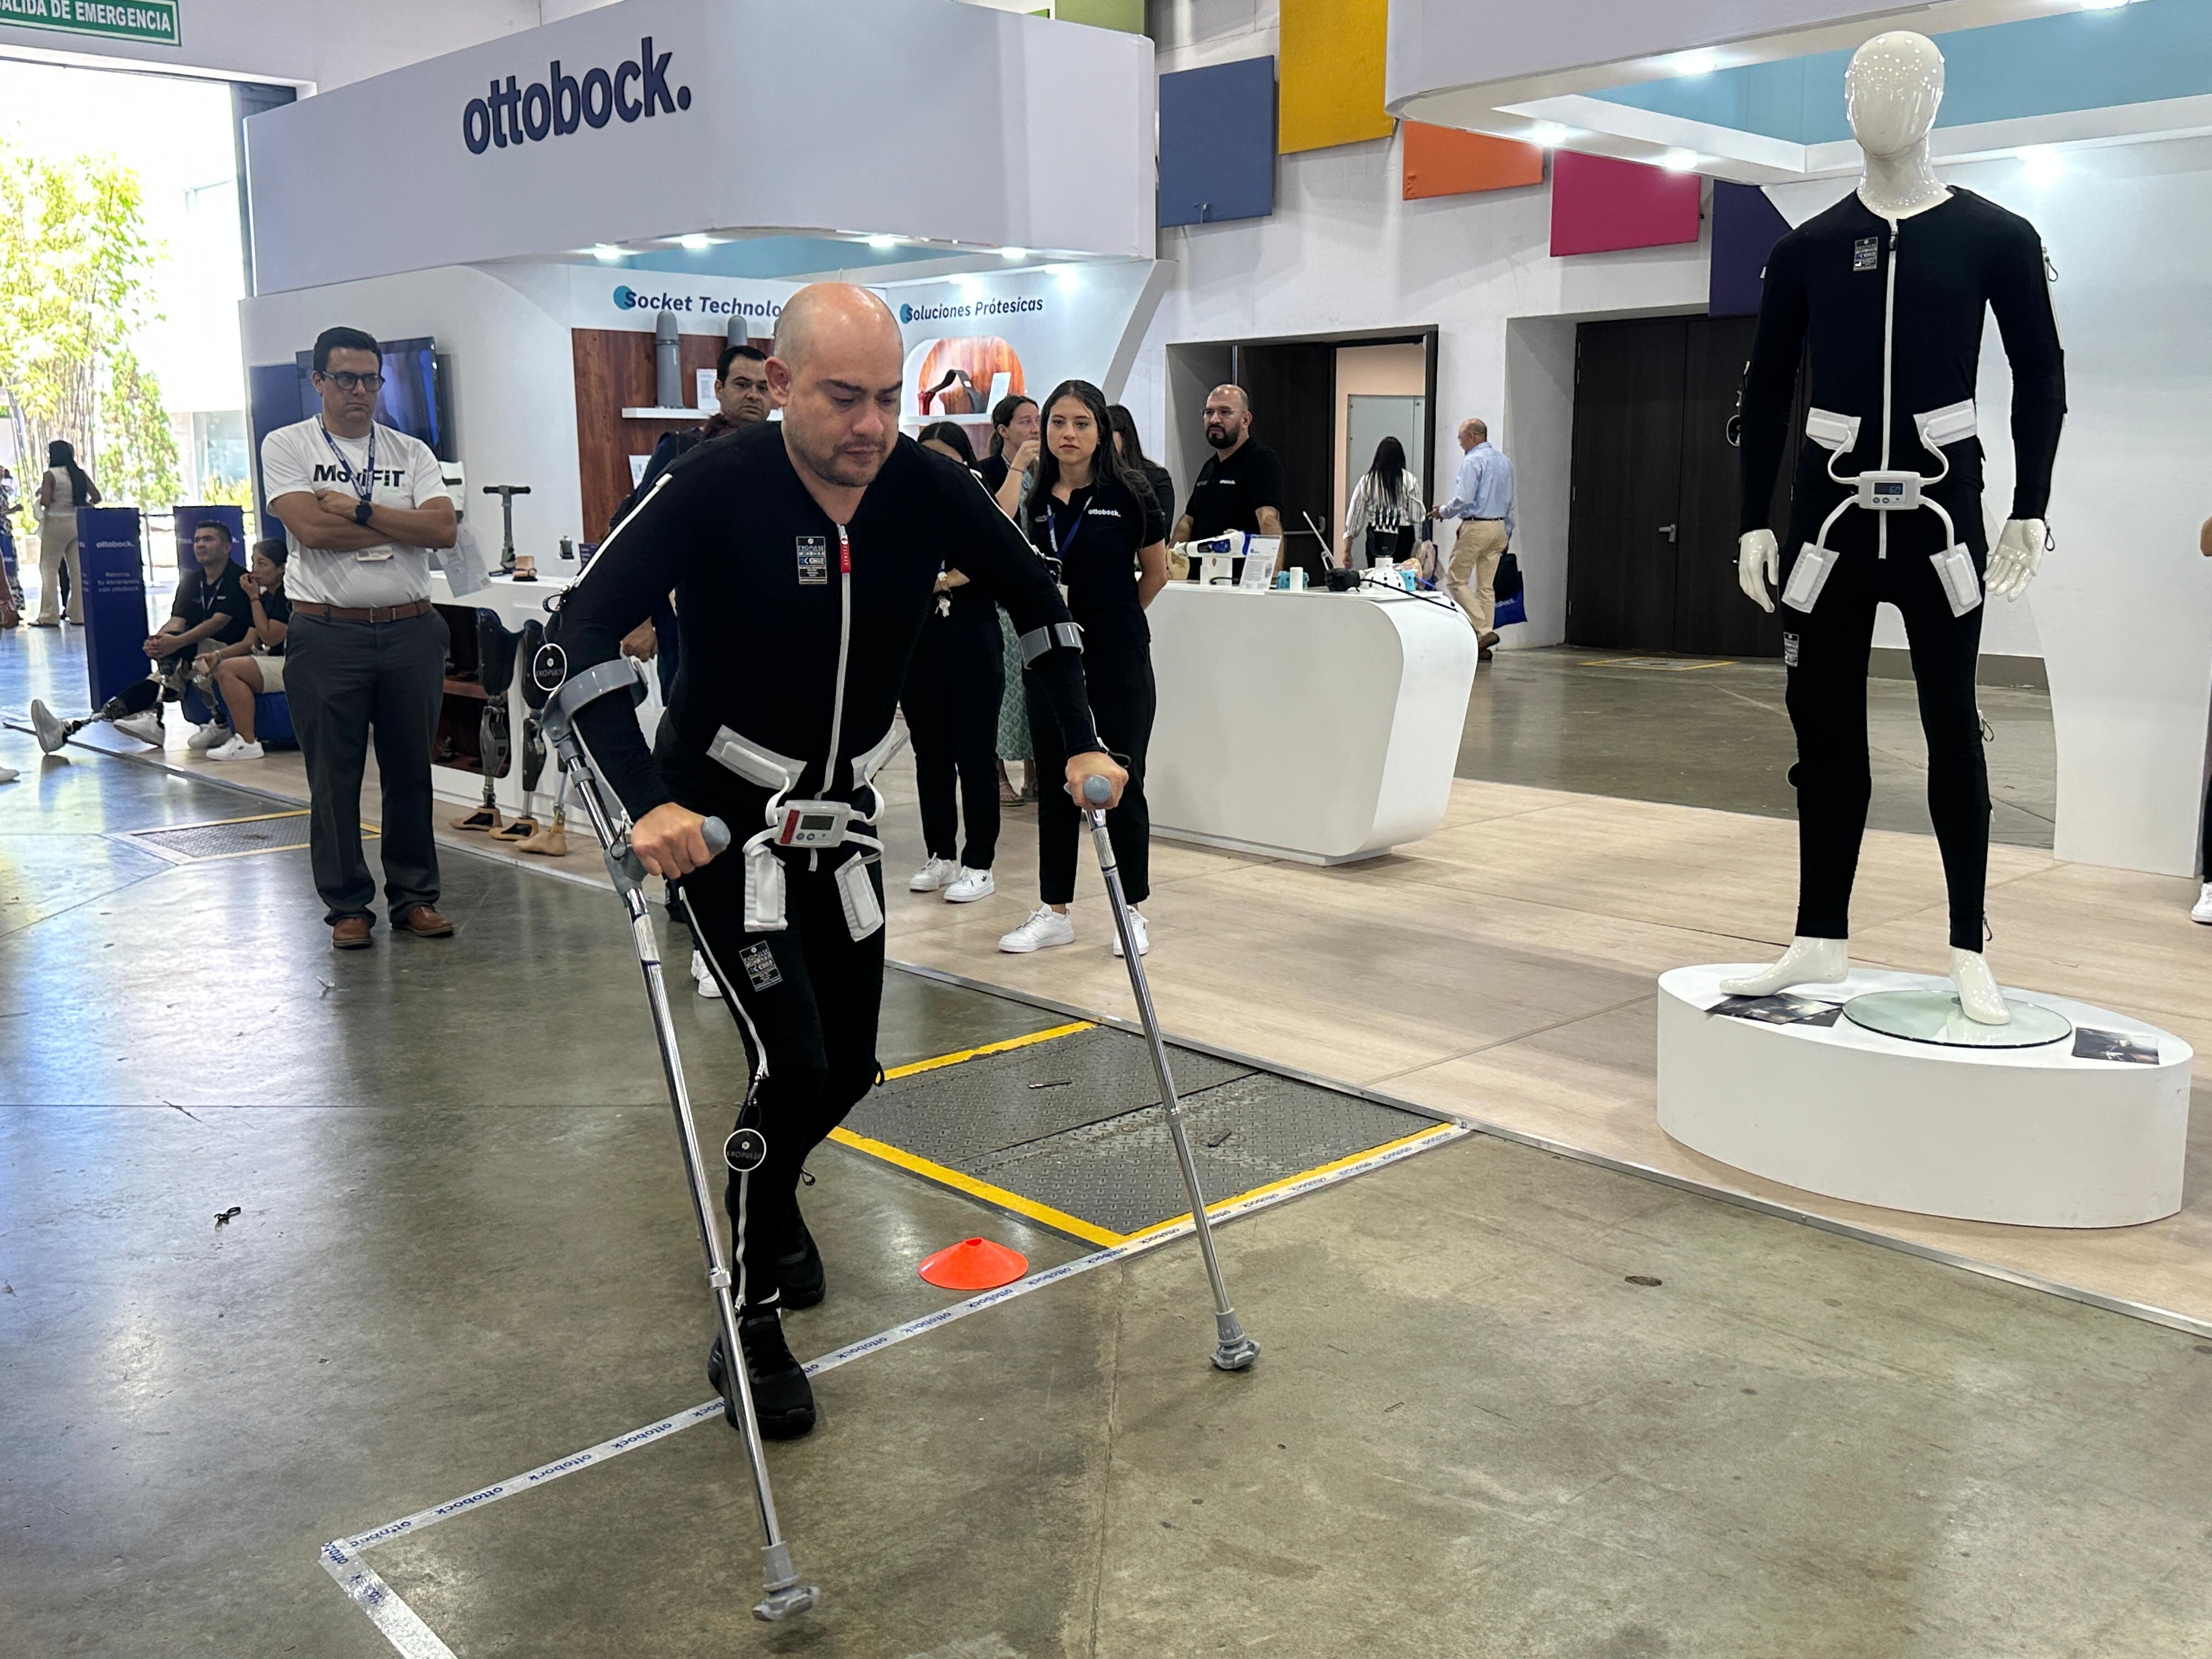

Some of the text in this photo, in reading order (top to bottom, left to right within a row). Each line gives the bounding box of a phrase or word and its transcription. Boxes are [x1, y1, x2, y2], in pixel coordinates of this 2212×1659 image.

[51, 0, 71, 19] DE
[75, 1, 171, 31] EMERGENCIA
[463, 36, 691, 154] ottobock.
[624, 290, 693, 311] Socket
[906, 296, 1043, 321] Soluciones Prótesicas
